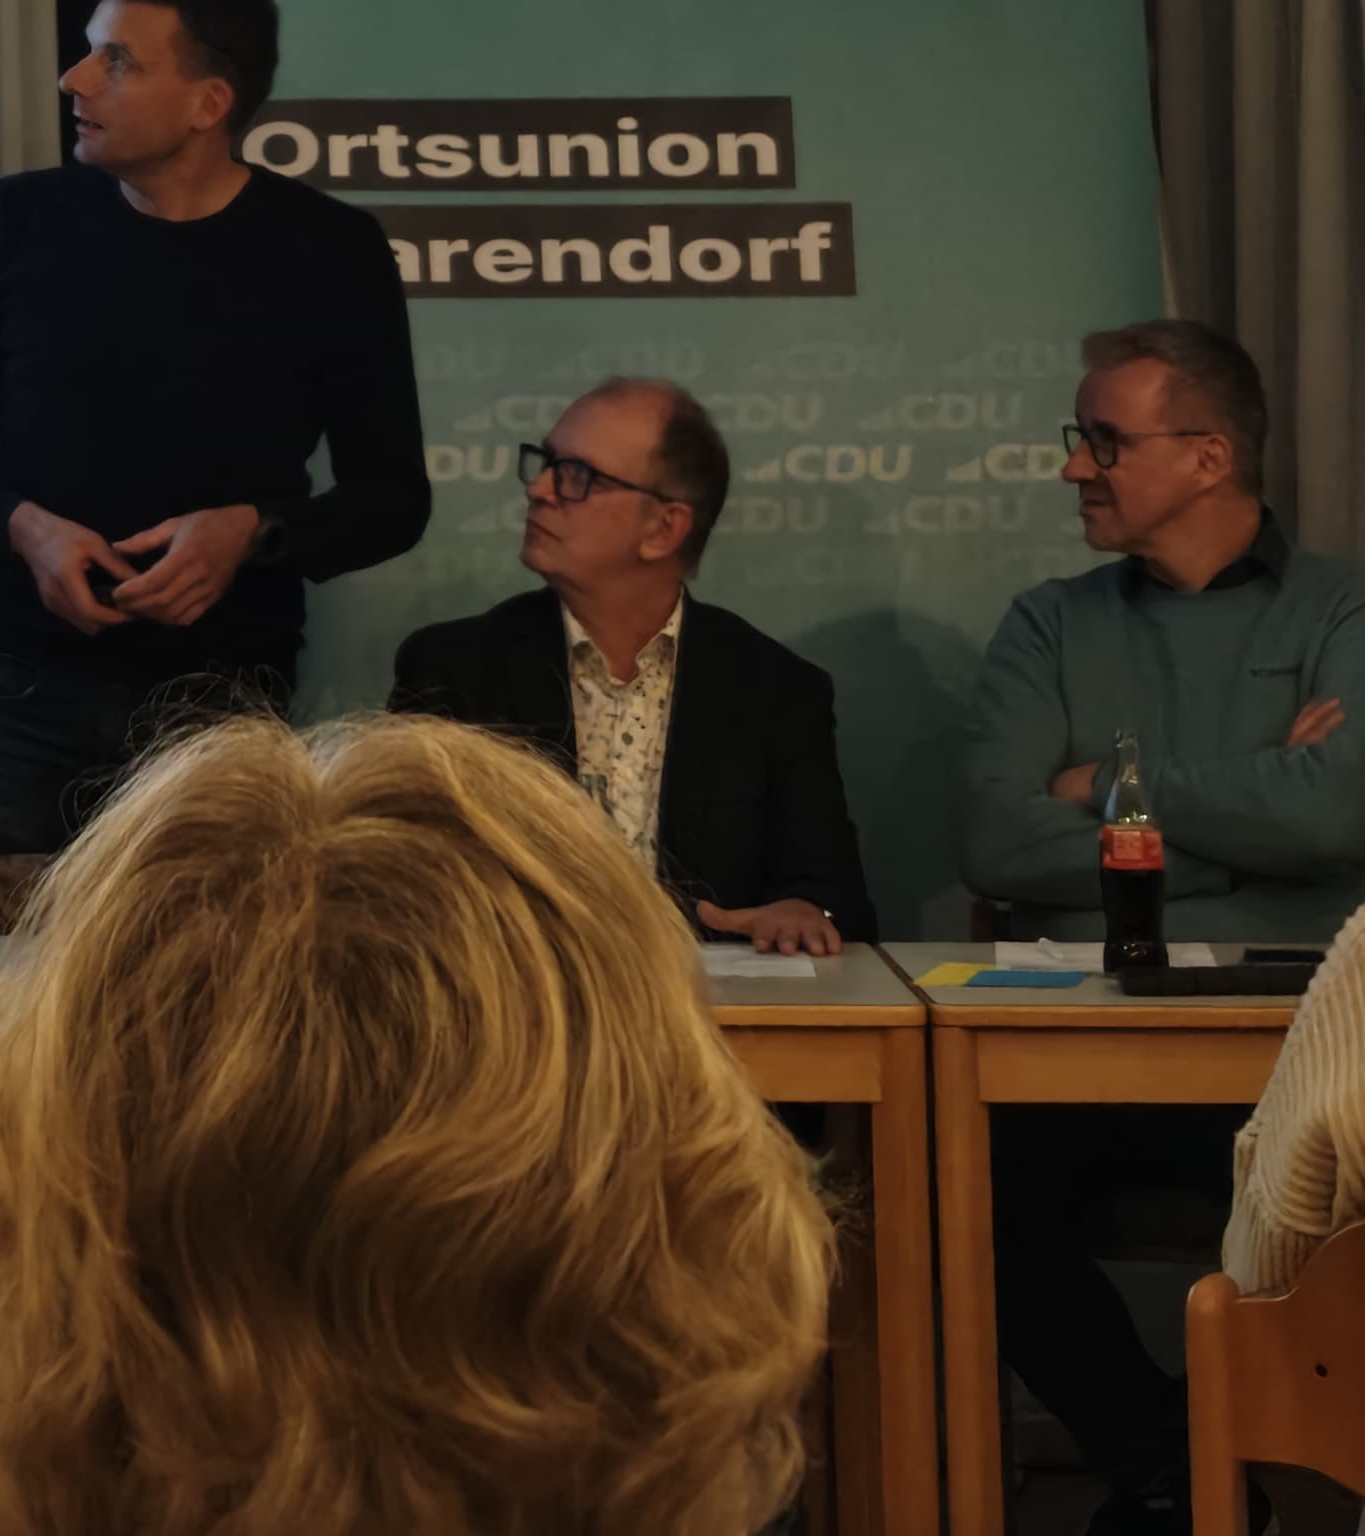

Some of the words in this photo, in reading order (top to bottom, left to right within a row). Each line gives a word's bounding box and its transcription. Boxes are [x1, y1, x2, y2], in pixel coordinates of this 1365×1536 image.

[242, 117, 779, 178] Ortsunion
[389, 221, 833, 283] arendorf
[895, 392, 1025, 430] CDU
[426, 445, 511, 482] DU
[784, 444, 914, 483] CDU
[984, 444, 1066, 481] CD
[904, 496, 1029, 533] CDU
